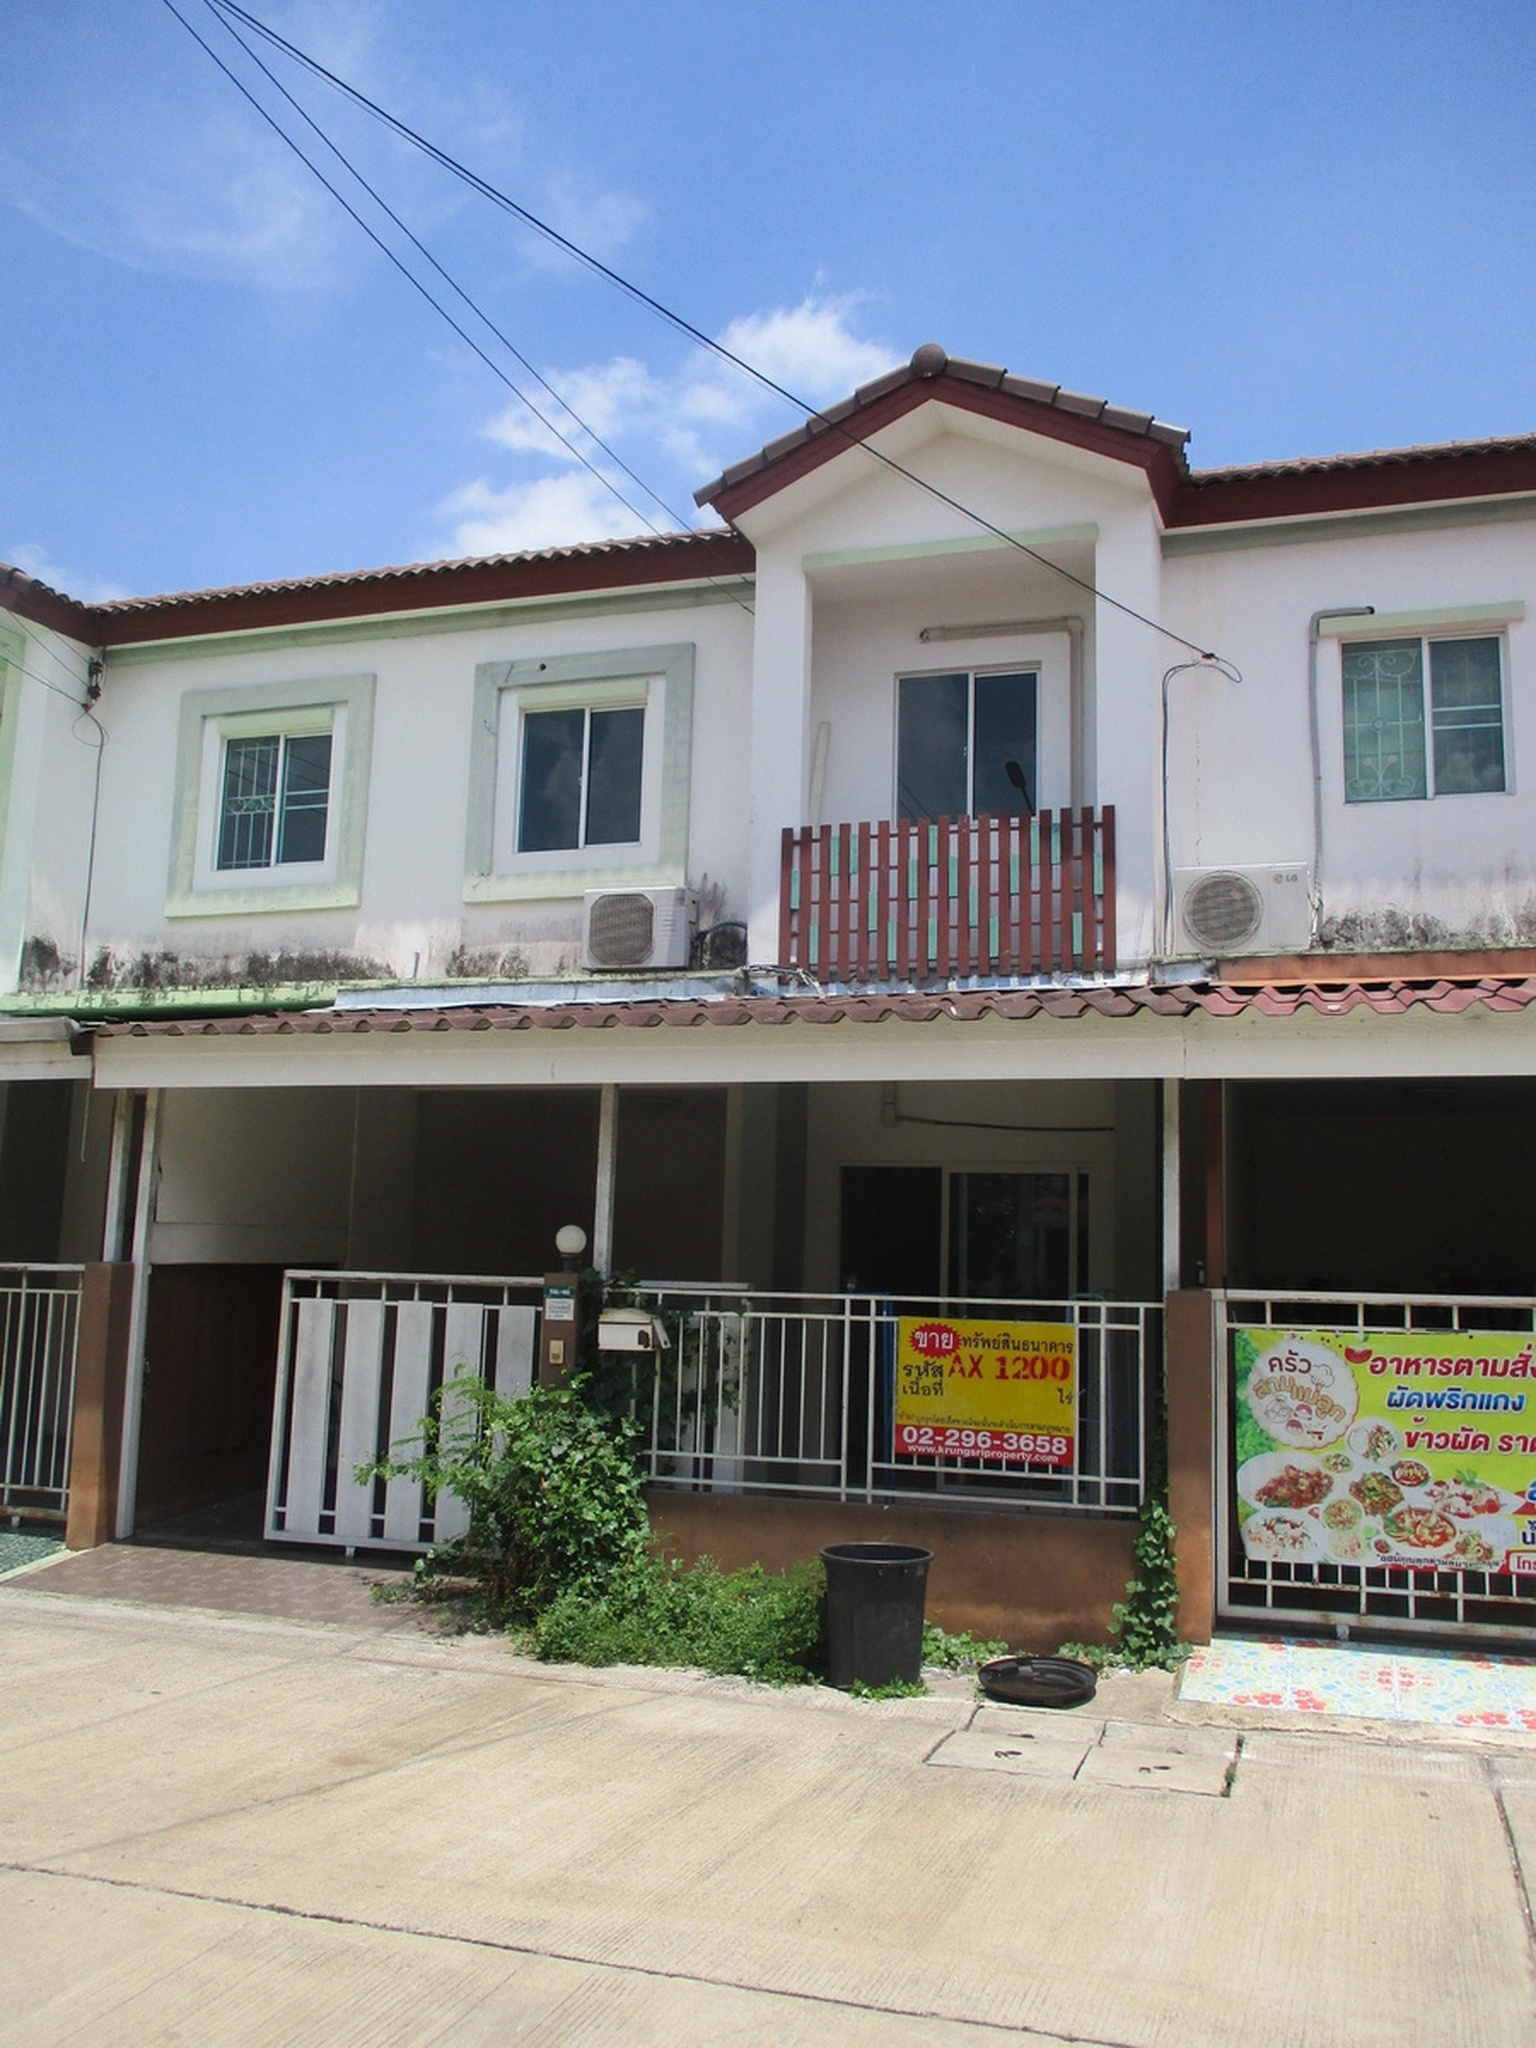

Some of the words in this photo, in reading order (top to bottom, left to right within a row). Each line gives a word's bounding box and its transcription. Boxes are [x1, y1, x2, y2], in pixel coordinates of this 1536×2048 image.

[914, 1330, 954, 1349] ขาย
[962, 1332, 1074, 1354] ทรัพย์สินธนาคาร
[902, 1360, 944, 1378] รหัส
[948, 1353, 984, 1379] AX
[995, 1356, 1072, 1381] 1200
[1268, 1349, 1312, 1374] ครัว
[902, 1377, 944, 1397] เนื้อที่
[1057, 1387, 1074, 1405] ไร่
[1252, 1375, 1347, 1423] สามแม่ลูก
[1386, 1385, 1526, 1412] ผัดพริกแกง
[902, 1425, 1068, 1455] 02-296-3658
[1405, 1416, 1490, 1451] ข้าวผัด
[907, 1444, 1059, 1463] www.krungsriproperty.com
